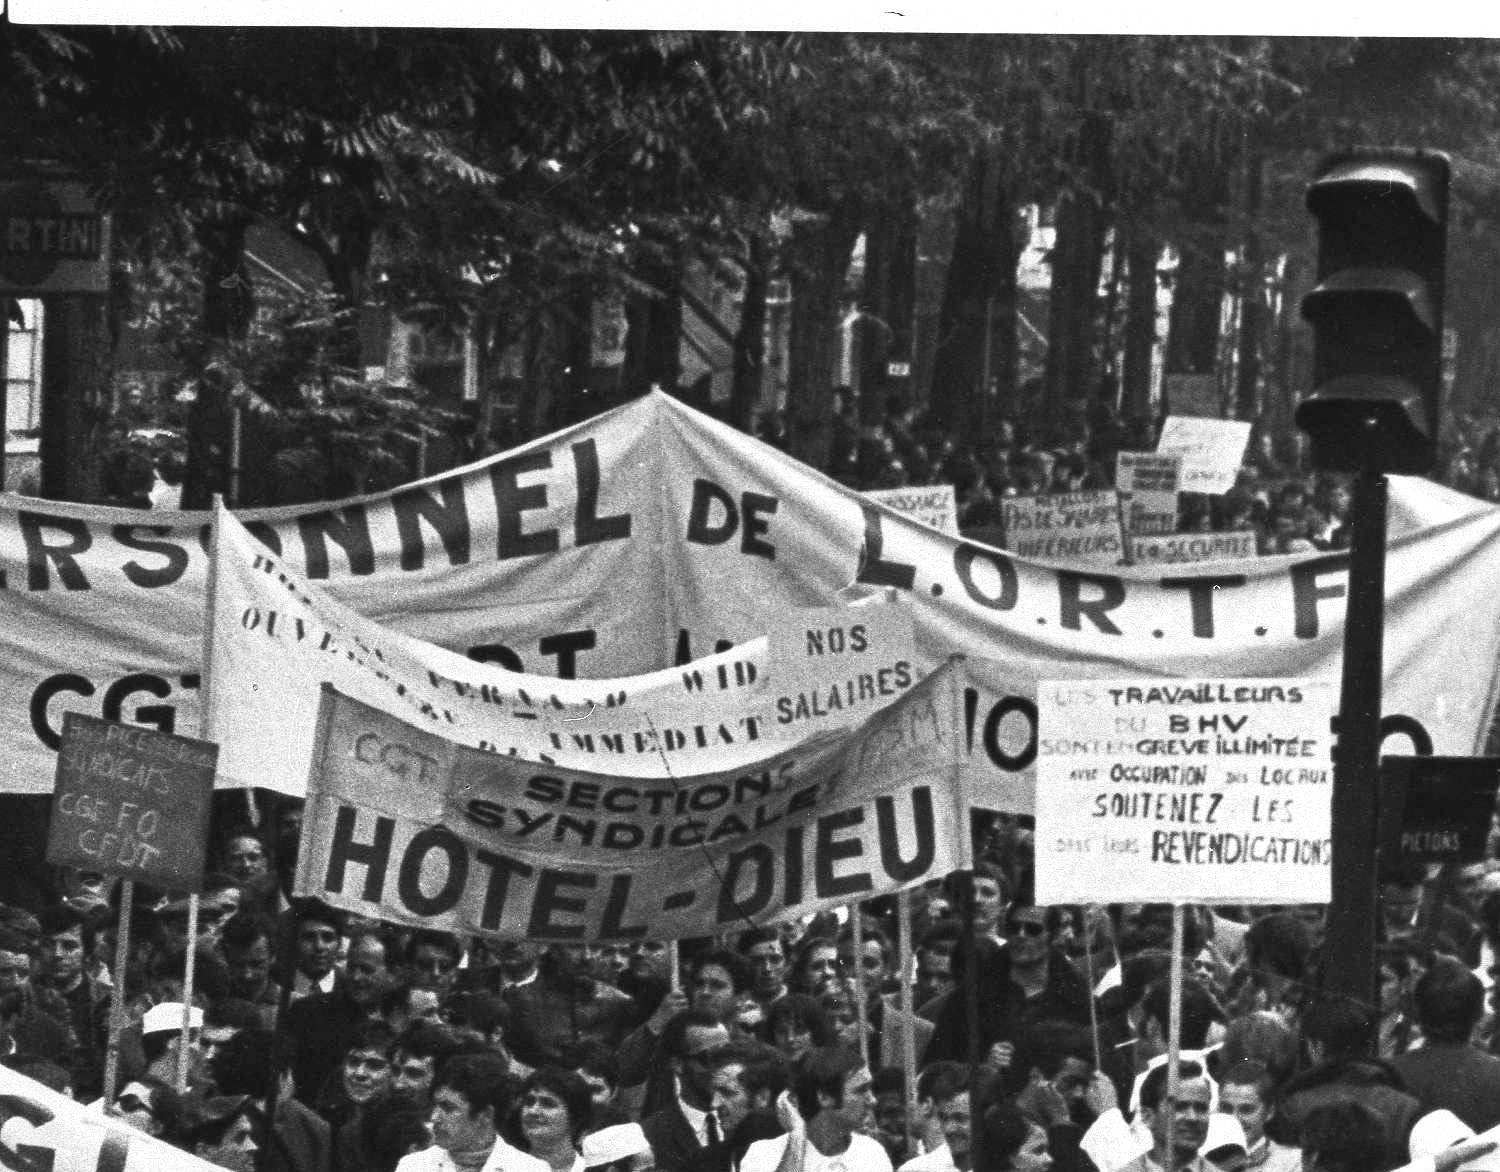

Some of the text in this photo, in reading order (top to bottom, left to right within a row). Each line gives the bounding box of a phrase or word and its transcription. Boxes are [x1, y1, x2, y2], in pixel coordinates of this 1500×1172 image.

[687, 477, 780, 561] DE
[806, 624, 869, 657] NOS
[776, 660, 913, 726] SALAIRES
[1108, 682, 1304, 706] TRAVAILLEURS
[1110, 762, 1208, 786] OCCUPATION
[1260, 765, 1329, 786] LOCAUX
[1091, 792, 1294, 824] SOUTENEZ LES
[323, 785, 937, 939] HOTEL-DIEU
[1151, 830, 1331, 866] REVENDICATIONS
